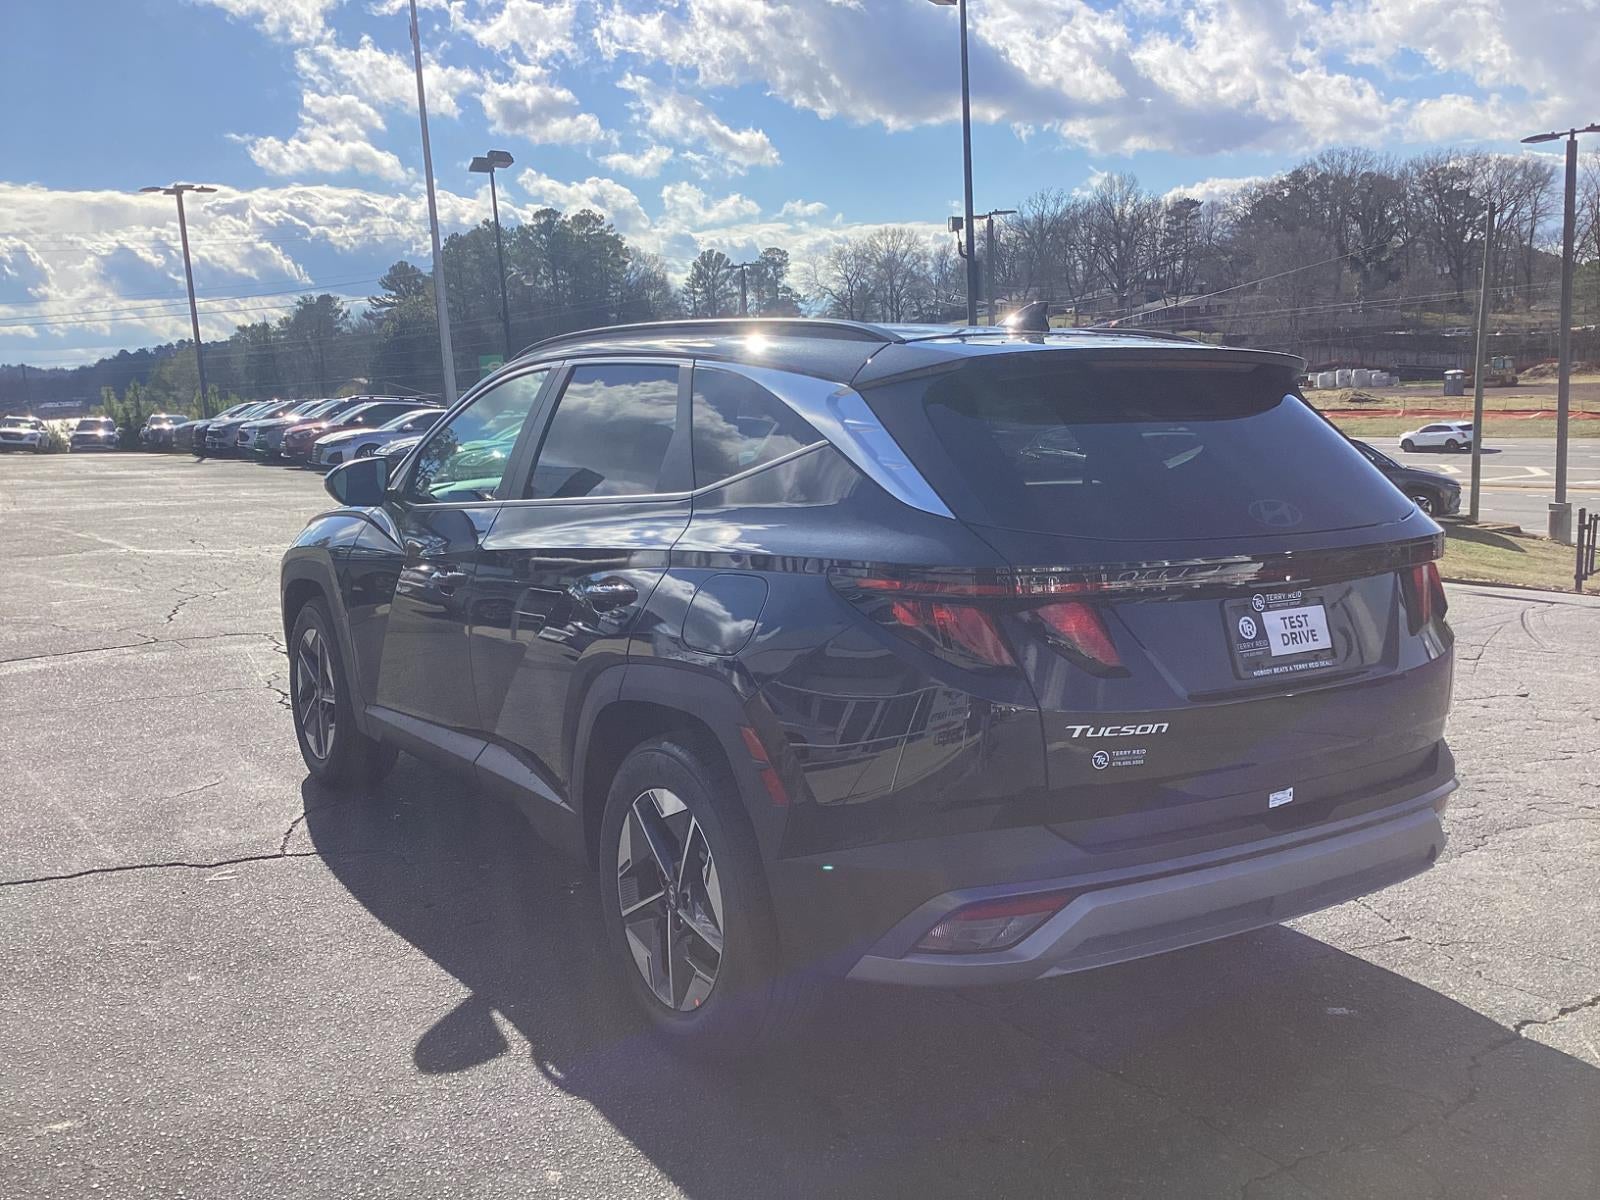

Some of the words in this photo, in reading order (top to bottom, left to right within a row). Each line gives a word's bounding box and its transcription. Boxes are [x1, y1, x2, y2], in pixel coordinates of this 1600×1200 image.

[1266, 593, 1286, 601] TERRY
[1280, 614, 1308, 630] TEST
[1281, 629, 1318, 646] DRIVE
[1236, 641, 1254, 650] TERRY
[1253, 669, 1273, 677] NOBODY
[1273, 666, 1289, 674] BEATS
